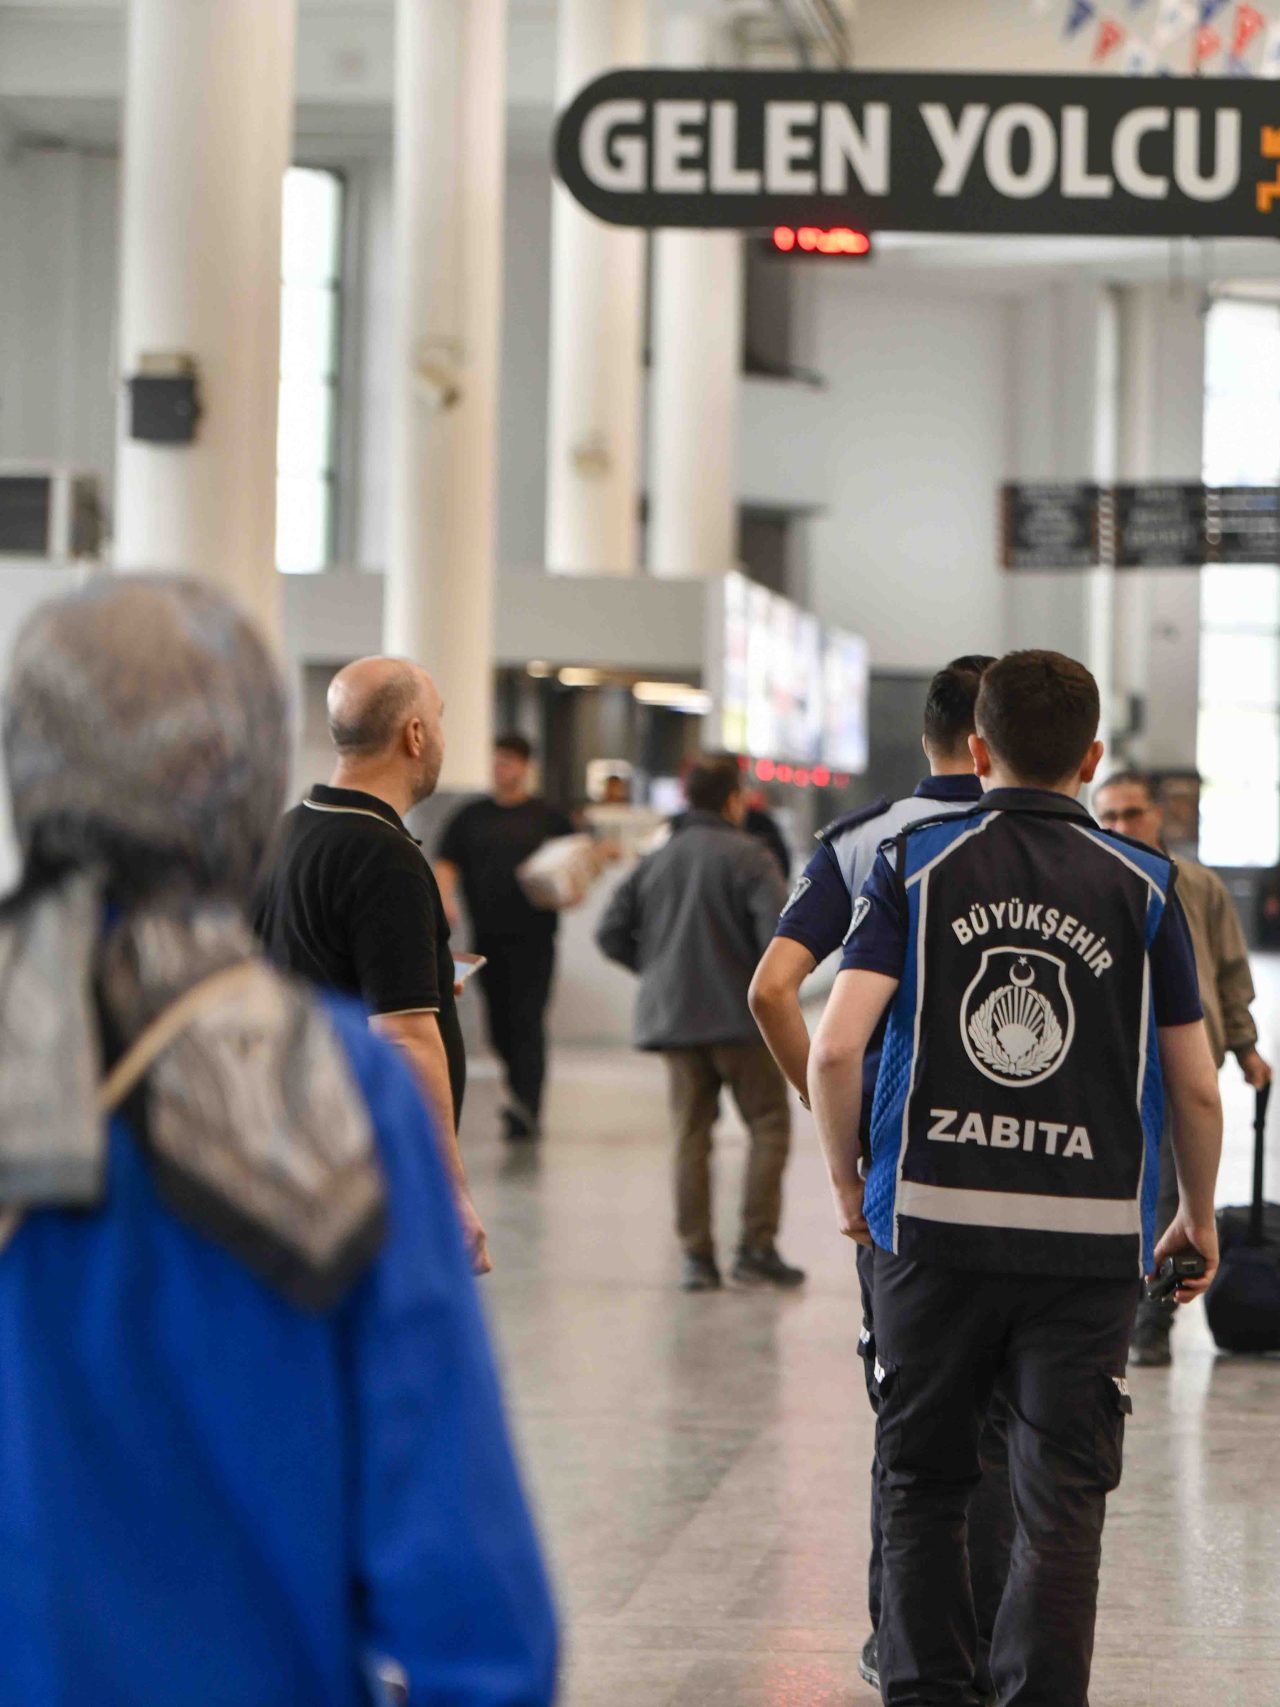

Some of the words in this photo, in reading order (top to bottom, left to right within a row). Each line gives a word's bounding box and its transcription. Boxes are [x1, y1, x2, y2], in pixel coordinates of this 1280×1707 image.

[579, 99, 890, 196] GELEN
[918, 102, 1242, 202] YOLCU
[951, 897, 1114, 979] BÜYÜKŞEHİR
[926, 1108, 1095, 1161] ZABITA
